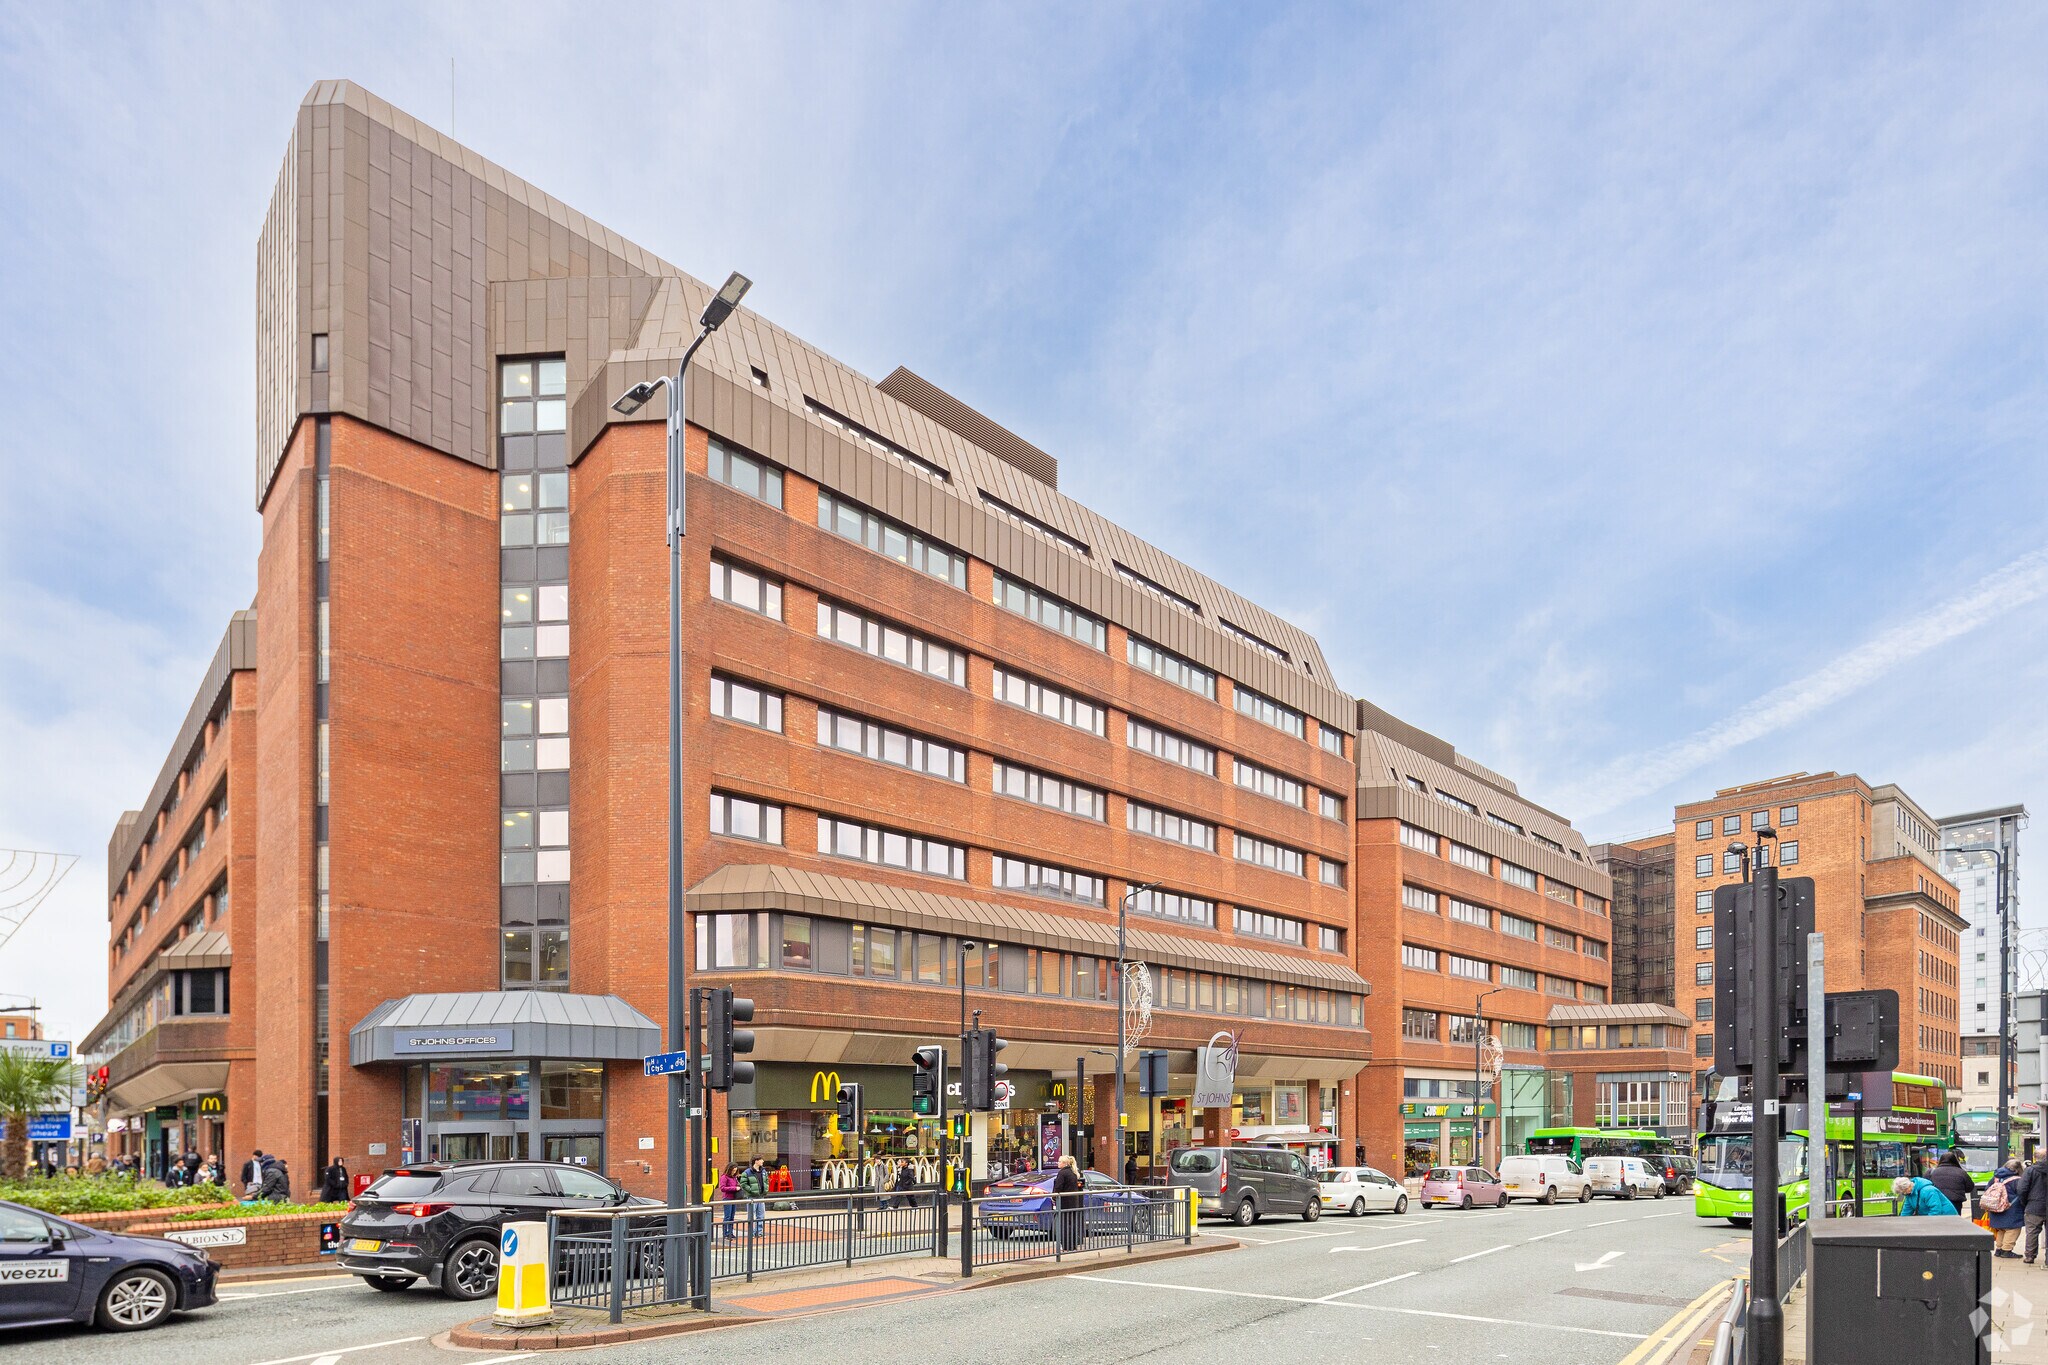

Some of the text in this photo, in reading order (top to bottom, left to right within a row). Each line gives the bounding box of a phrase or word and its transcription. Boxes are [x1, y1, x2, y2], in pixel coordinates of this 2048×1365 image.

[421, 1037, 455, 1046] JOHNS
[456, 1036, 496, 1045] OFFICES
[1205, 1092, 1231, 1105] JOHNS
[1424, 1104, 1450, 1117] SUBWAY
[1770, 1101, 1775, 1112] 1
